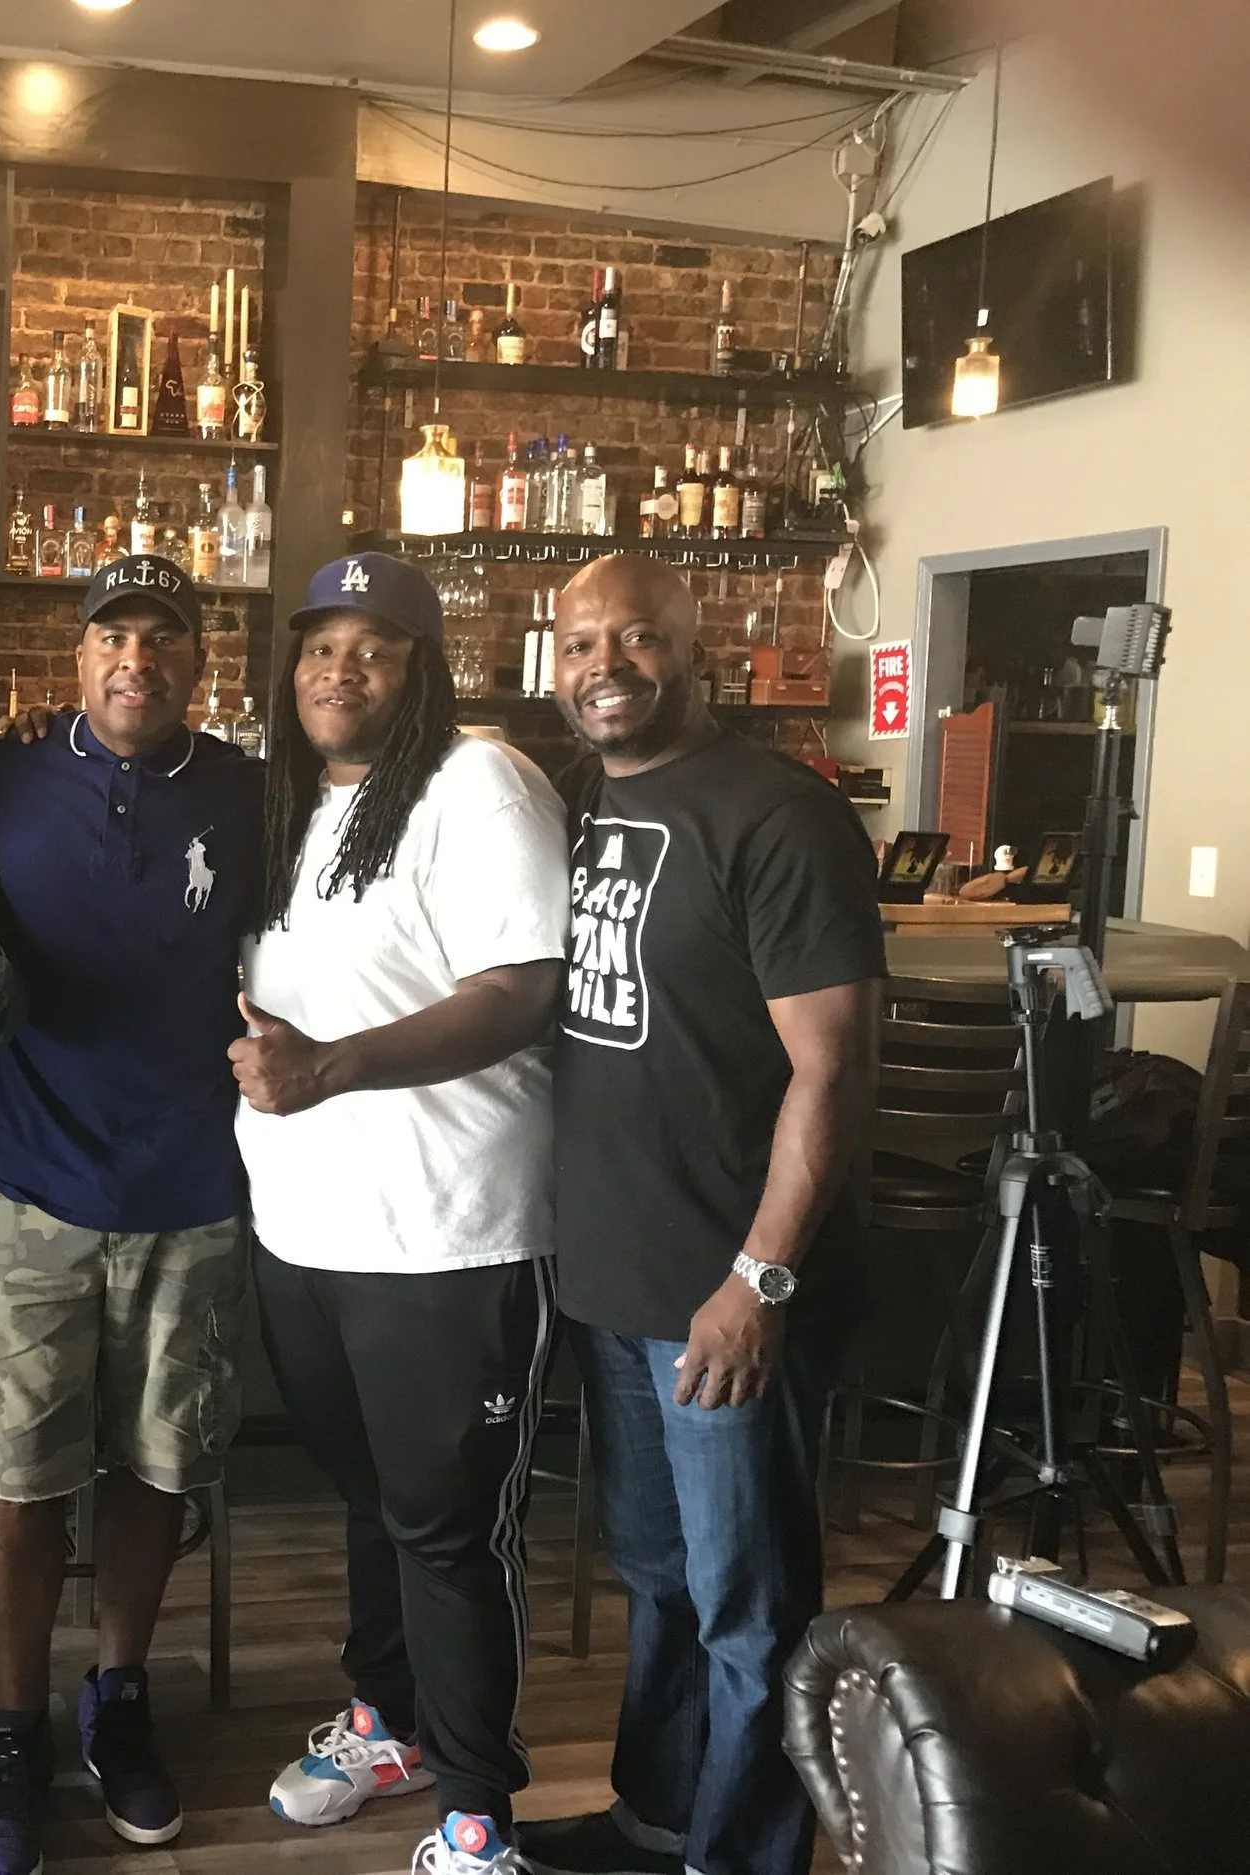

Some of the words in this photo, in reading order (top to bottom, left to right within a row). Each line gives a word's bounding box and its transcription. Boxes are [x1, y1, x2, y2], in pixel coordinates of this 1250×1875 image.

[106, 568, 129, 591] RL
[159, 570, 181, 593] 67
[341, 560, 370, 592] LA
[878, 655, 904, 678] FIRE
[596, 832, 624, 870] A
